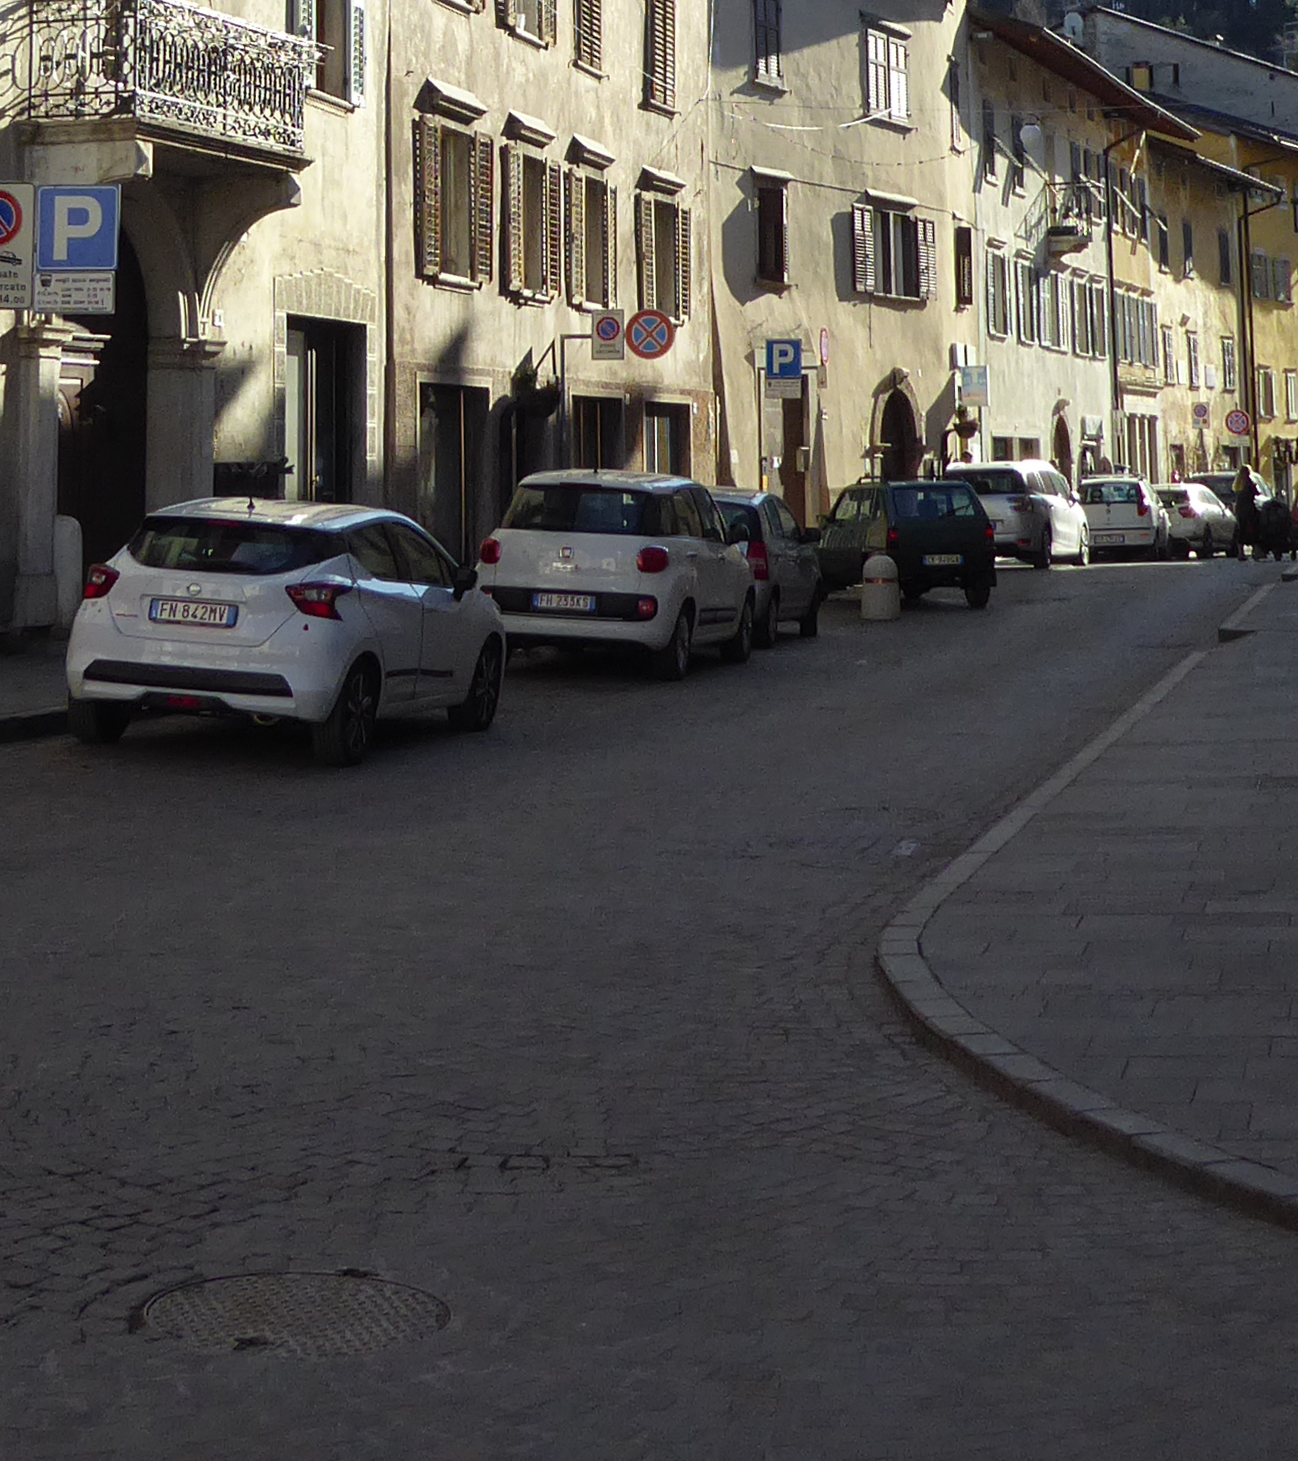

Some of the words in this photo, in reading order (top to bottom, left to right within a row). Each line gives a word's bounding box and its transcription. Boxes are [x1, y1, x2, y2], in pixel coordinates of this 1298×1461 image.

[52, 195, 103, 261] P
[773, 343, 794, 374] P
[159, 602, 178, 618] FN
[181, 604, 227, 622] 842MV
